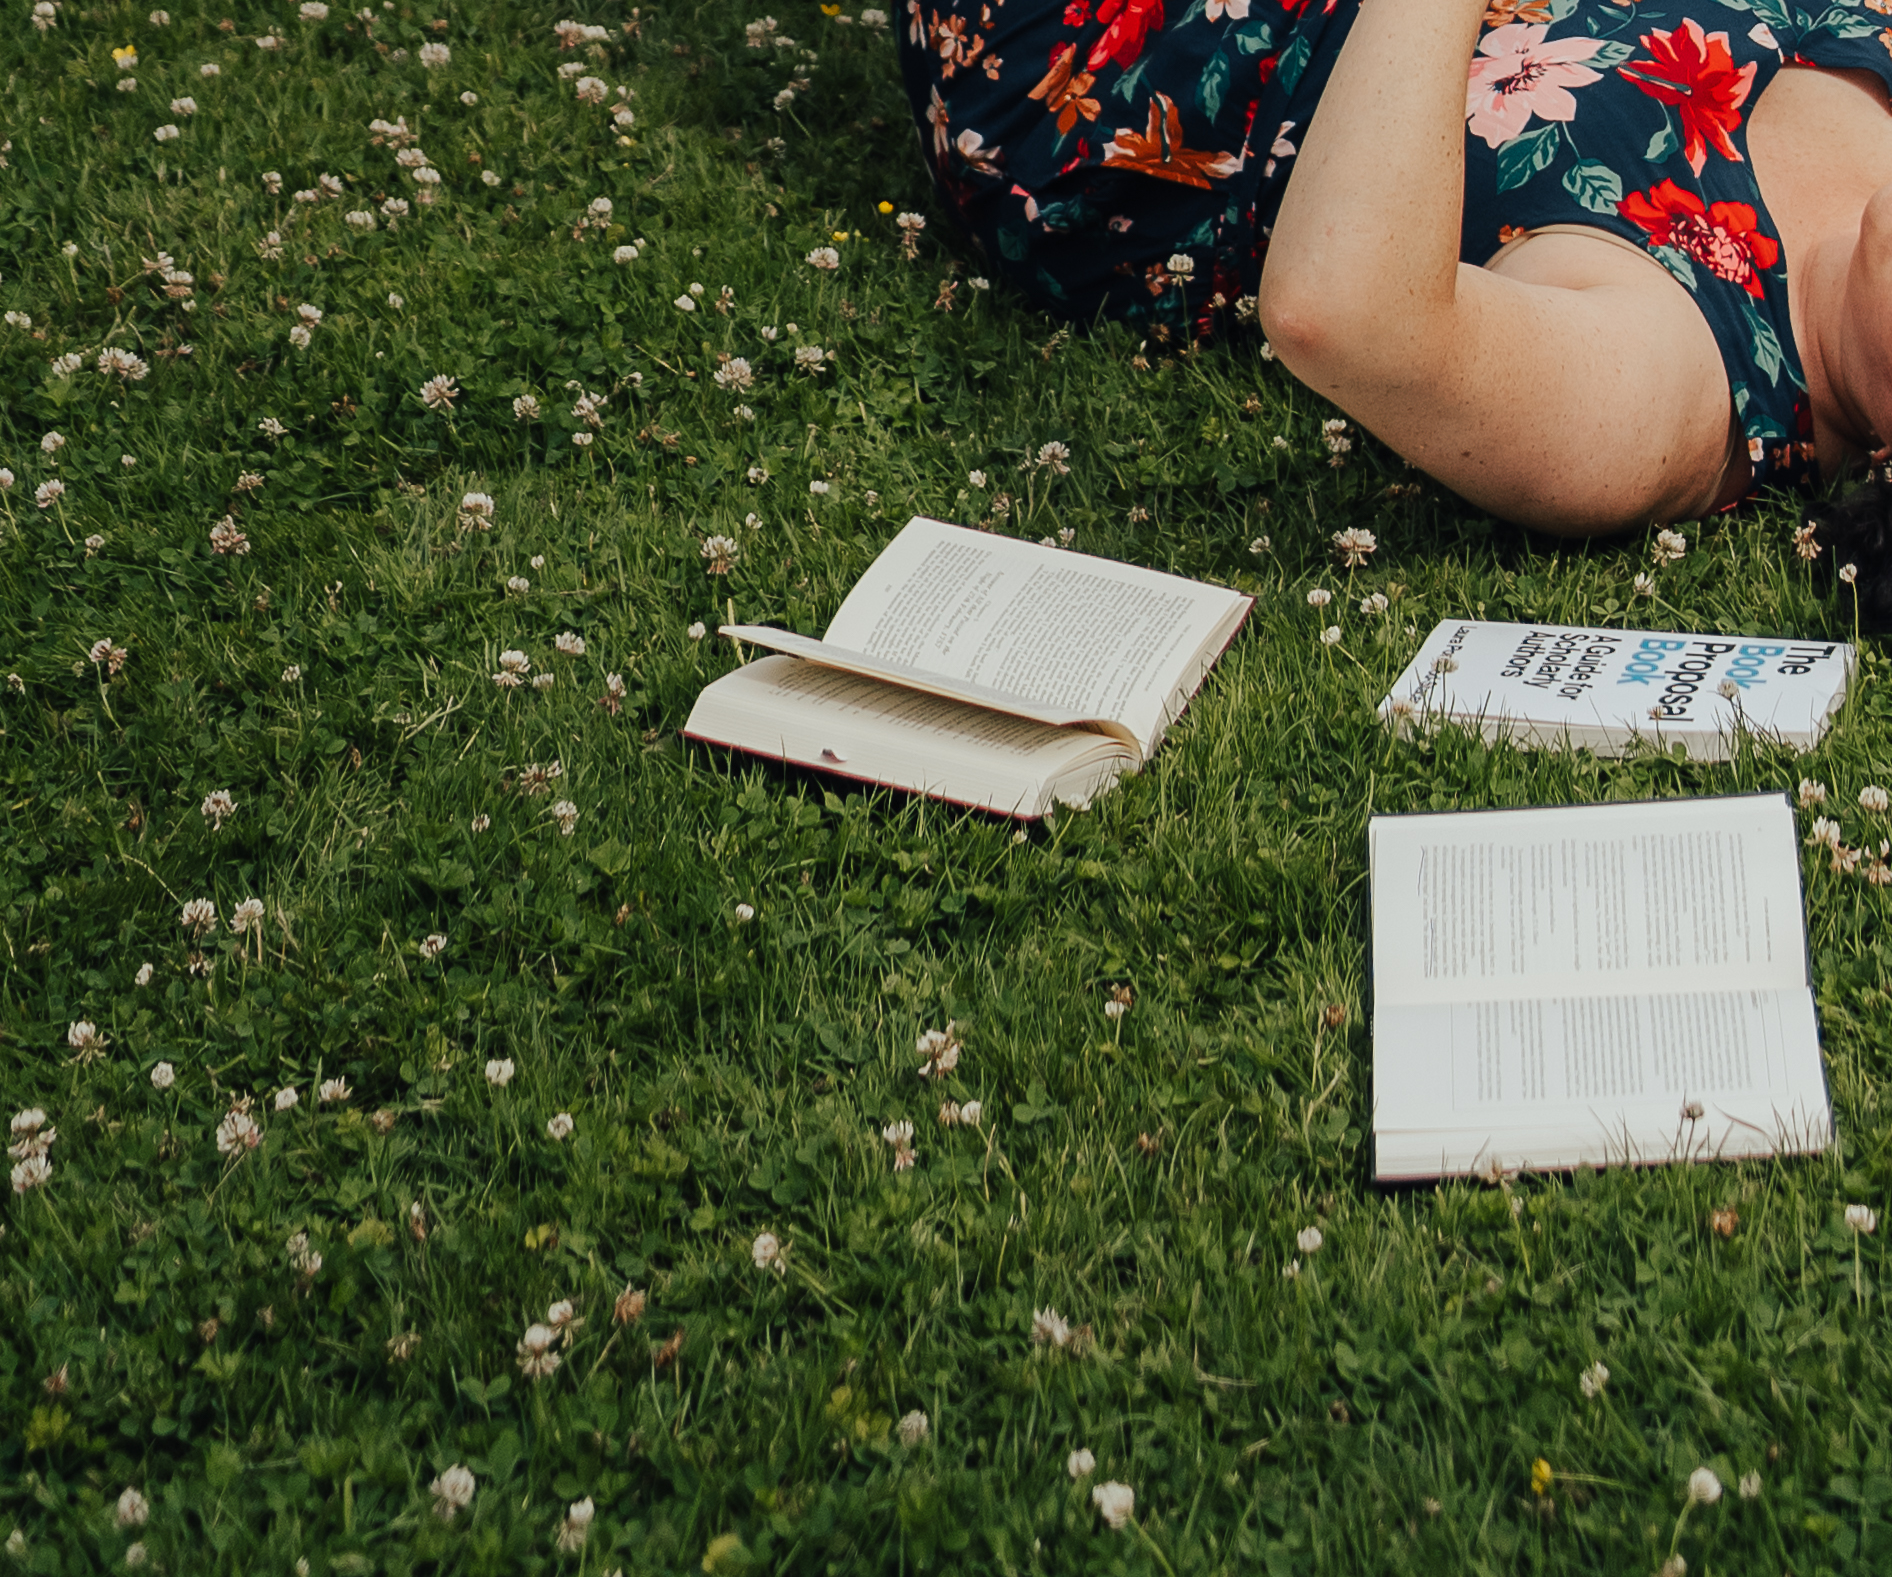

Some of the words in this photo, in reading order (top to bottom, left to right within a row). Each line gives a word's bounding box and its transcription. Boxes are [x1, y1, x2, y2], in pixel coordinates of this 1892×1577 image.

[1500, 630, 1556, 677] Authors
[1523, 633, 1589, 689] Scholarly
[1593, 634, 1622, 643] A
[1616, 637, 1686, 686] Book
[1778, 646, 1836, 674] The
[1569, 644, 1616, 680] Guide
[1649, 641, 1736, 722] Proposal
[1725, 644, 1785, 690] Book
[1558, 680, 1595, 701] for
